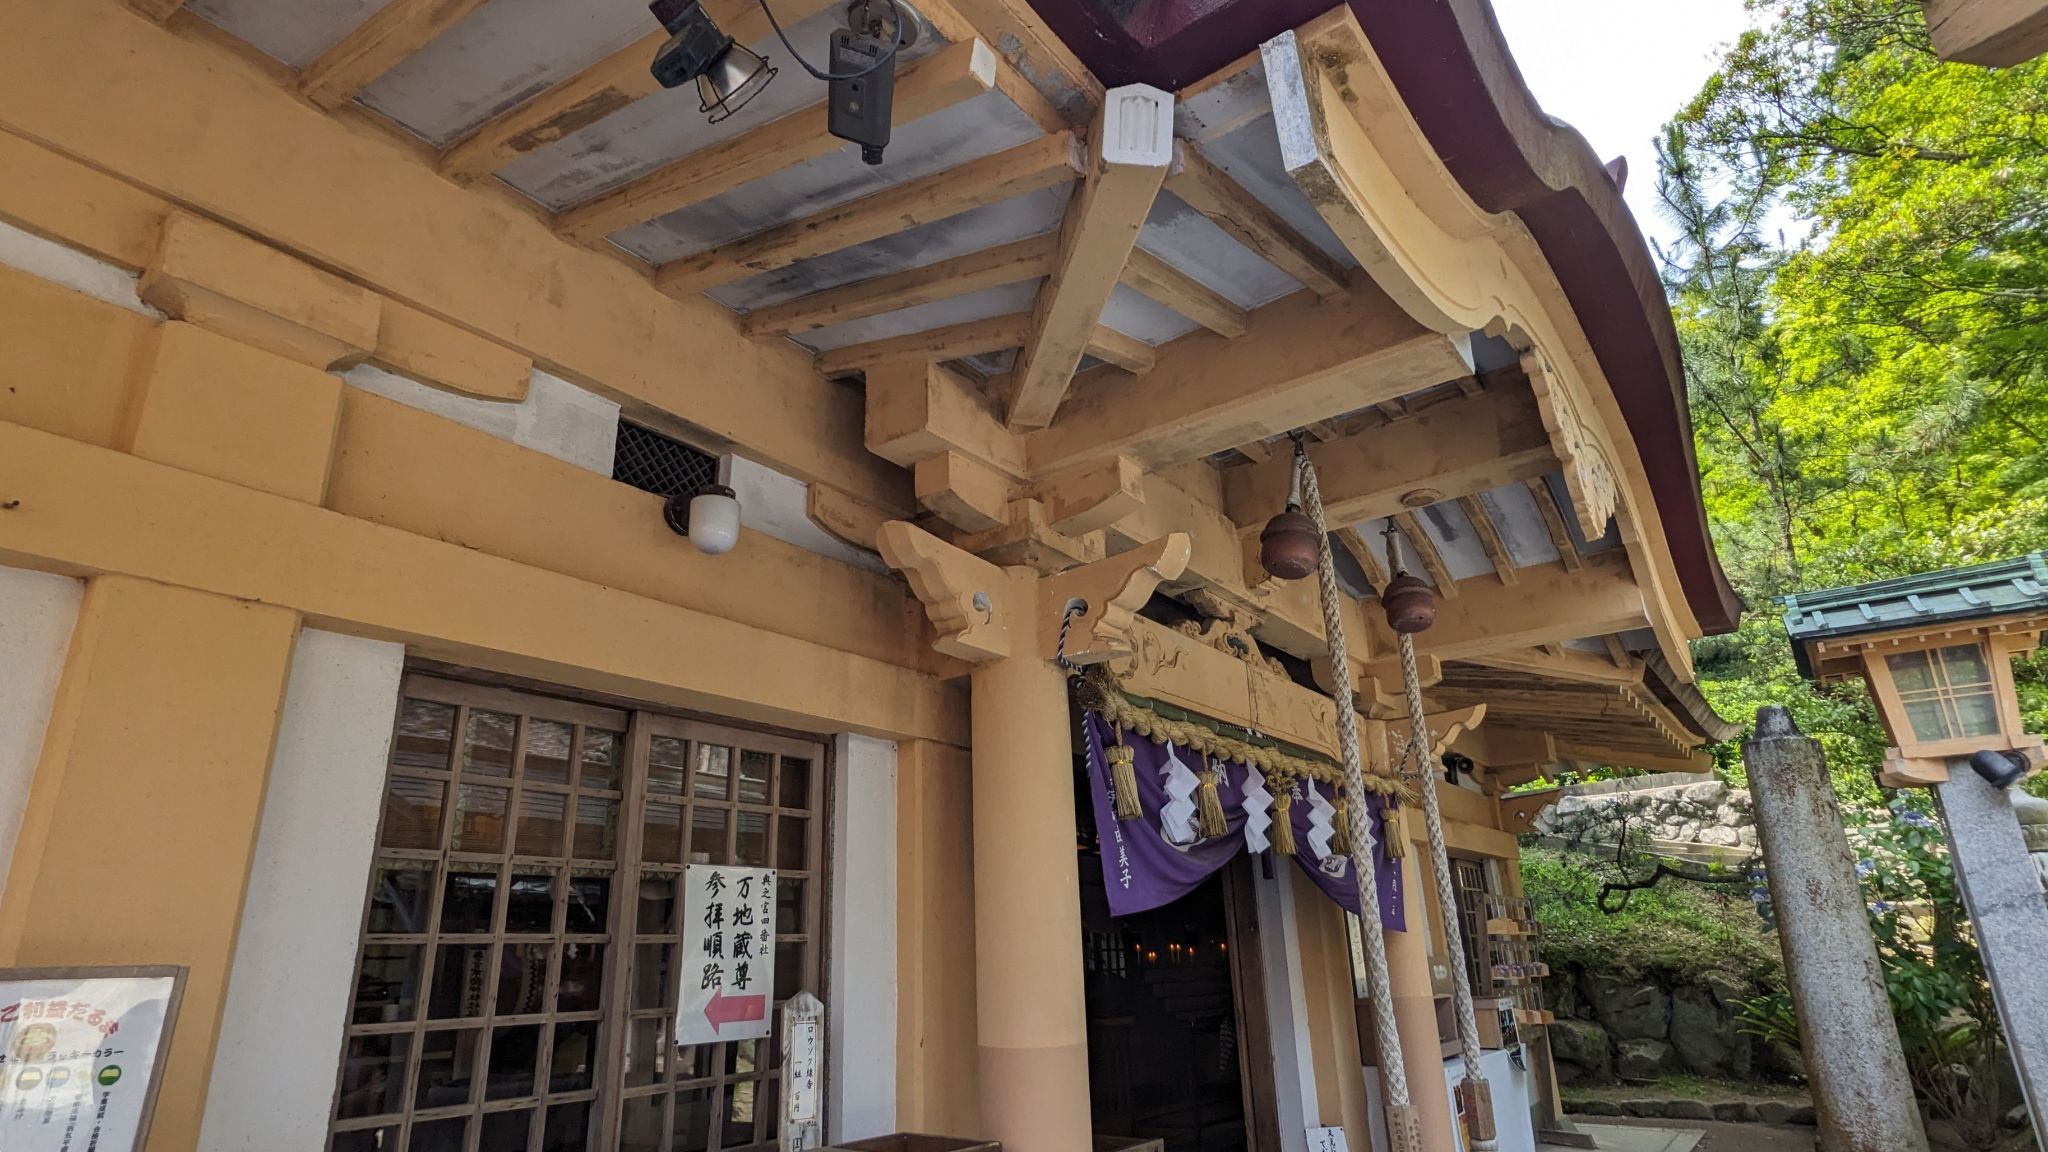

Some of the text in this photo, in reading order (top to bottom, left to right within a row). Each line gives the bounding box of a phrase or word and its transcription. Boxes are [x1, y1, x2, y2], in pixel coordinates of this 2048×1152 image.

[701, 870, 726, 990] 参拝順路
[731, 876, 754, 991] 万地蔵尊
